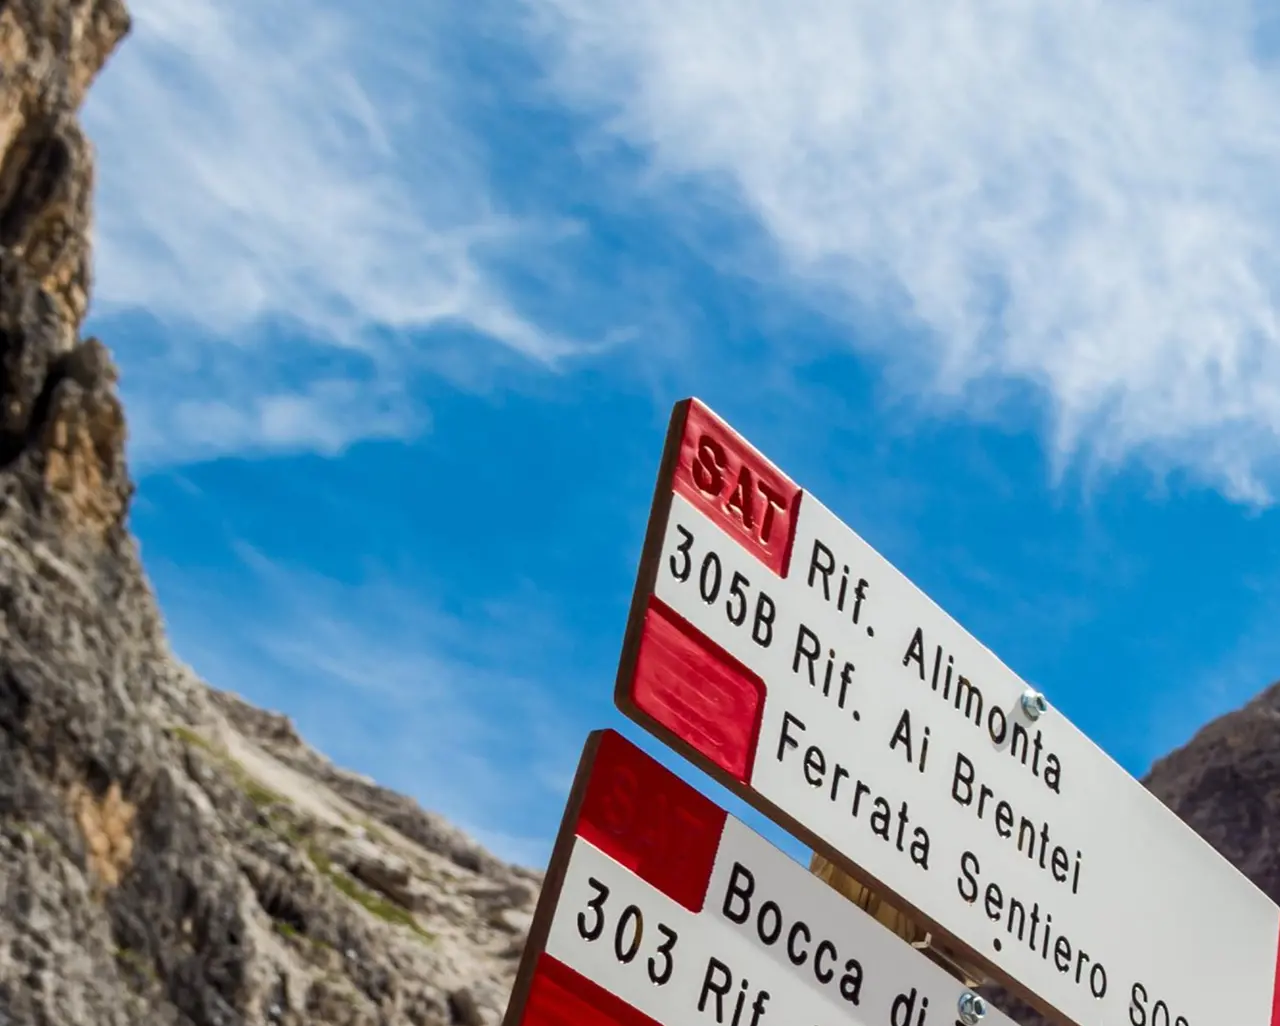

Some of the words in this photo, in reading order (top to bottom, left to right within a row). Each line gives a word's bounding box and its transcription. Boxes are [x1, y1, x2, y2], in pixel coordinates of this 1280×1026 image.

[692, 434, 790, 546] SAT
[670, 525, 776, 648] 305B
[793, 624, 860, 722] Rif.
[890, 710, 930, 773] Ai
[952, 752, 1084, 895] Brentei
[808, 540, 874, 637] Rif.
[902, 627, 1062, 796] Alimonta
[577, 876, 678, 986] 303
[723, 862, 864, 1007] Bocca
[777, 712, 931, 871] Ferrata
[957, 851, 1107, 999] Sentiero
